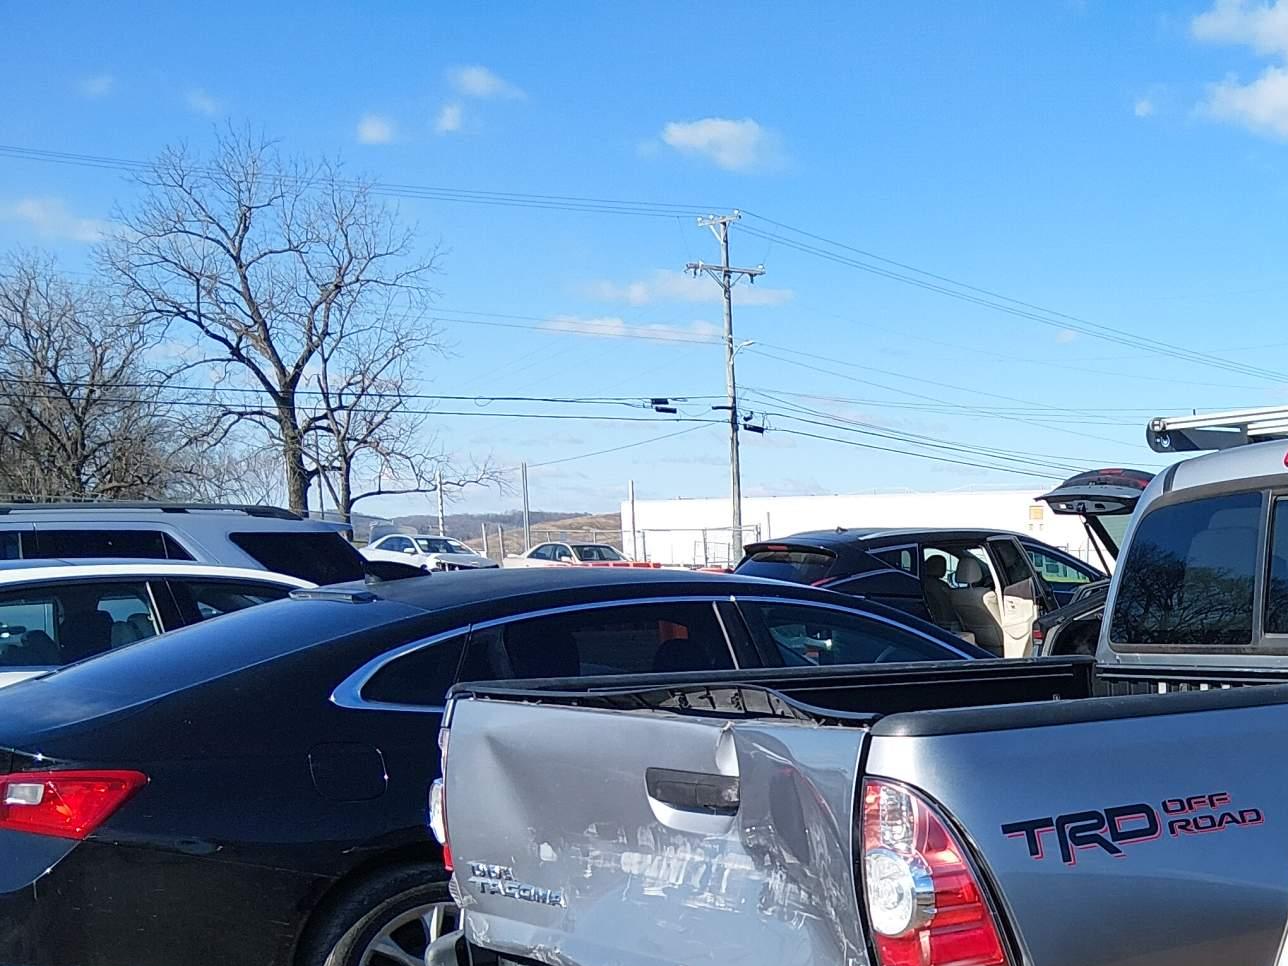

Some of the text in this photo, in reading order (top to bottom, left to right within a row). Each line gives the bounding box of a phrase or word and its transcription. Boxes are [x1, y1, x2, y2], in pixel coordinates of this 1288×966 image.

[1161, 791, 1232, 815] OFF
[1001, 803, 1163, 866] TRD
[1167, 808, 1266, 837] ROAD
